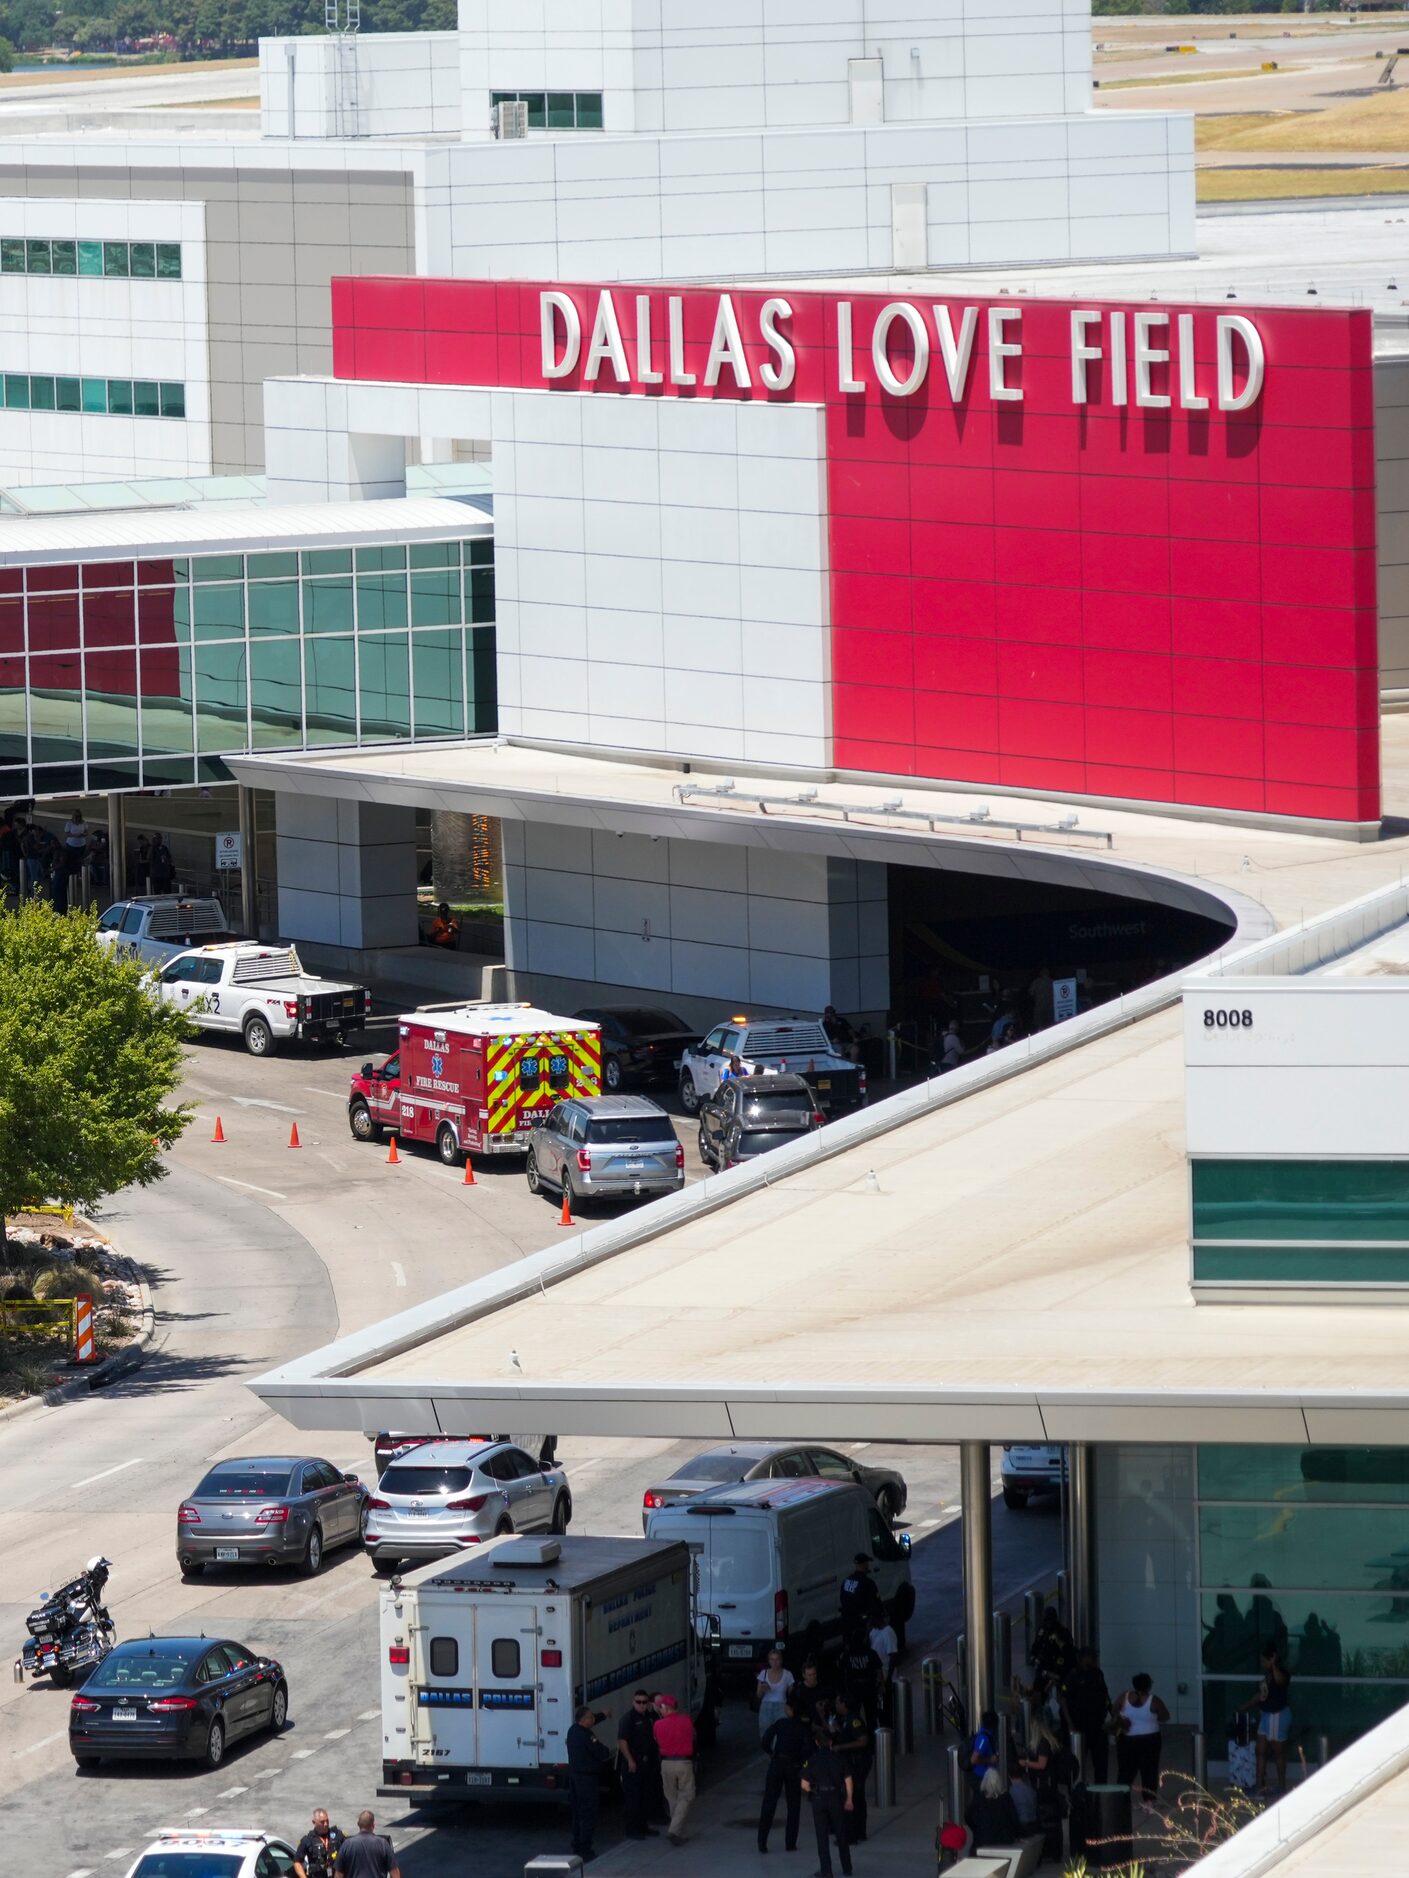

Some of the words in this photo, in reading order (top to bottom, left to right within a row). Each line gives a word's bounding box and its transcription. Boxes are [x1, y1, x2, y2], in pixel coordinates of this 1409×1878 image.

[540, 289, 796, 391] DALLAS
[837, 301, 1024, 403] LOVE
[1070, 309, 1264, 411] FIELD
[1203, 1009, 1253, 1027] 8008
[423, 1039, 450, 1053] DALLAS
[416, 1075, 432, 1088] FIRE
[433, 1079, 460, 1093] RESCUE
[401, 1105, 414, 1117] 218
[420, 1691, 471, 1703] DALLAS
[482, 1694, 532, 1704] POLICE
[422, 1749, 451, 1757] 2167
